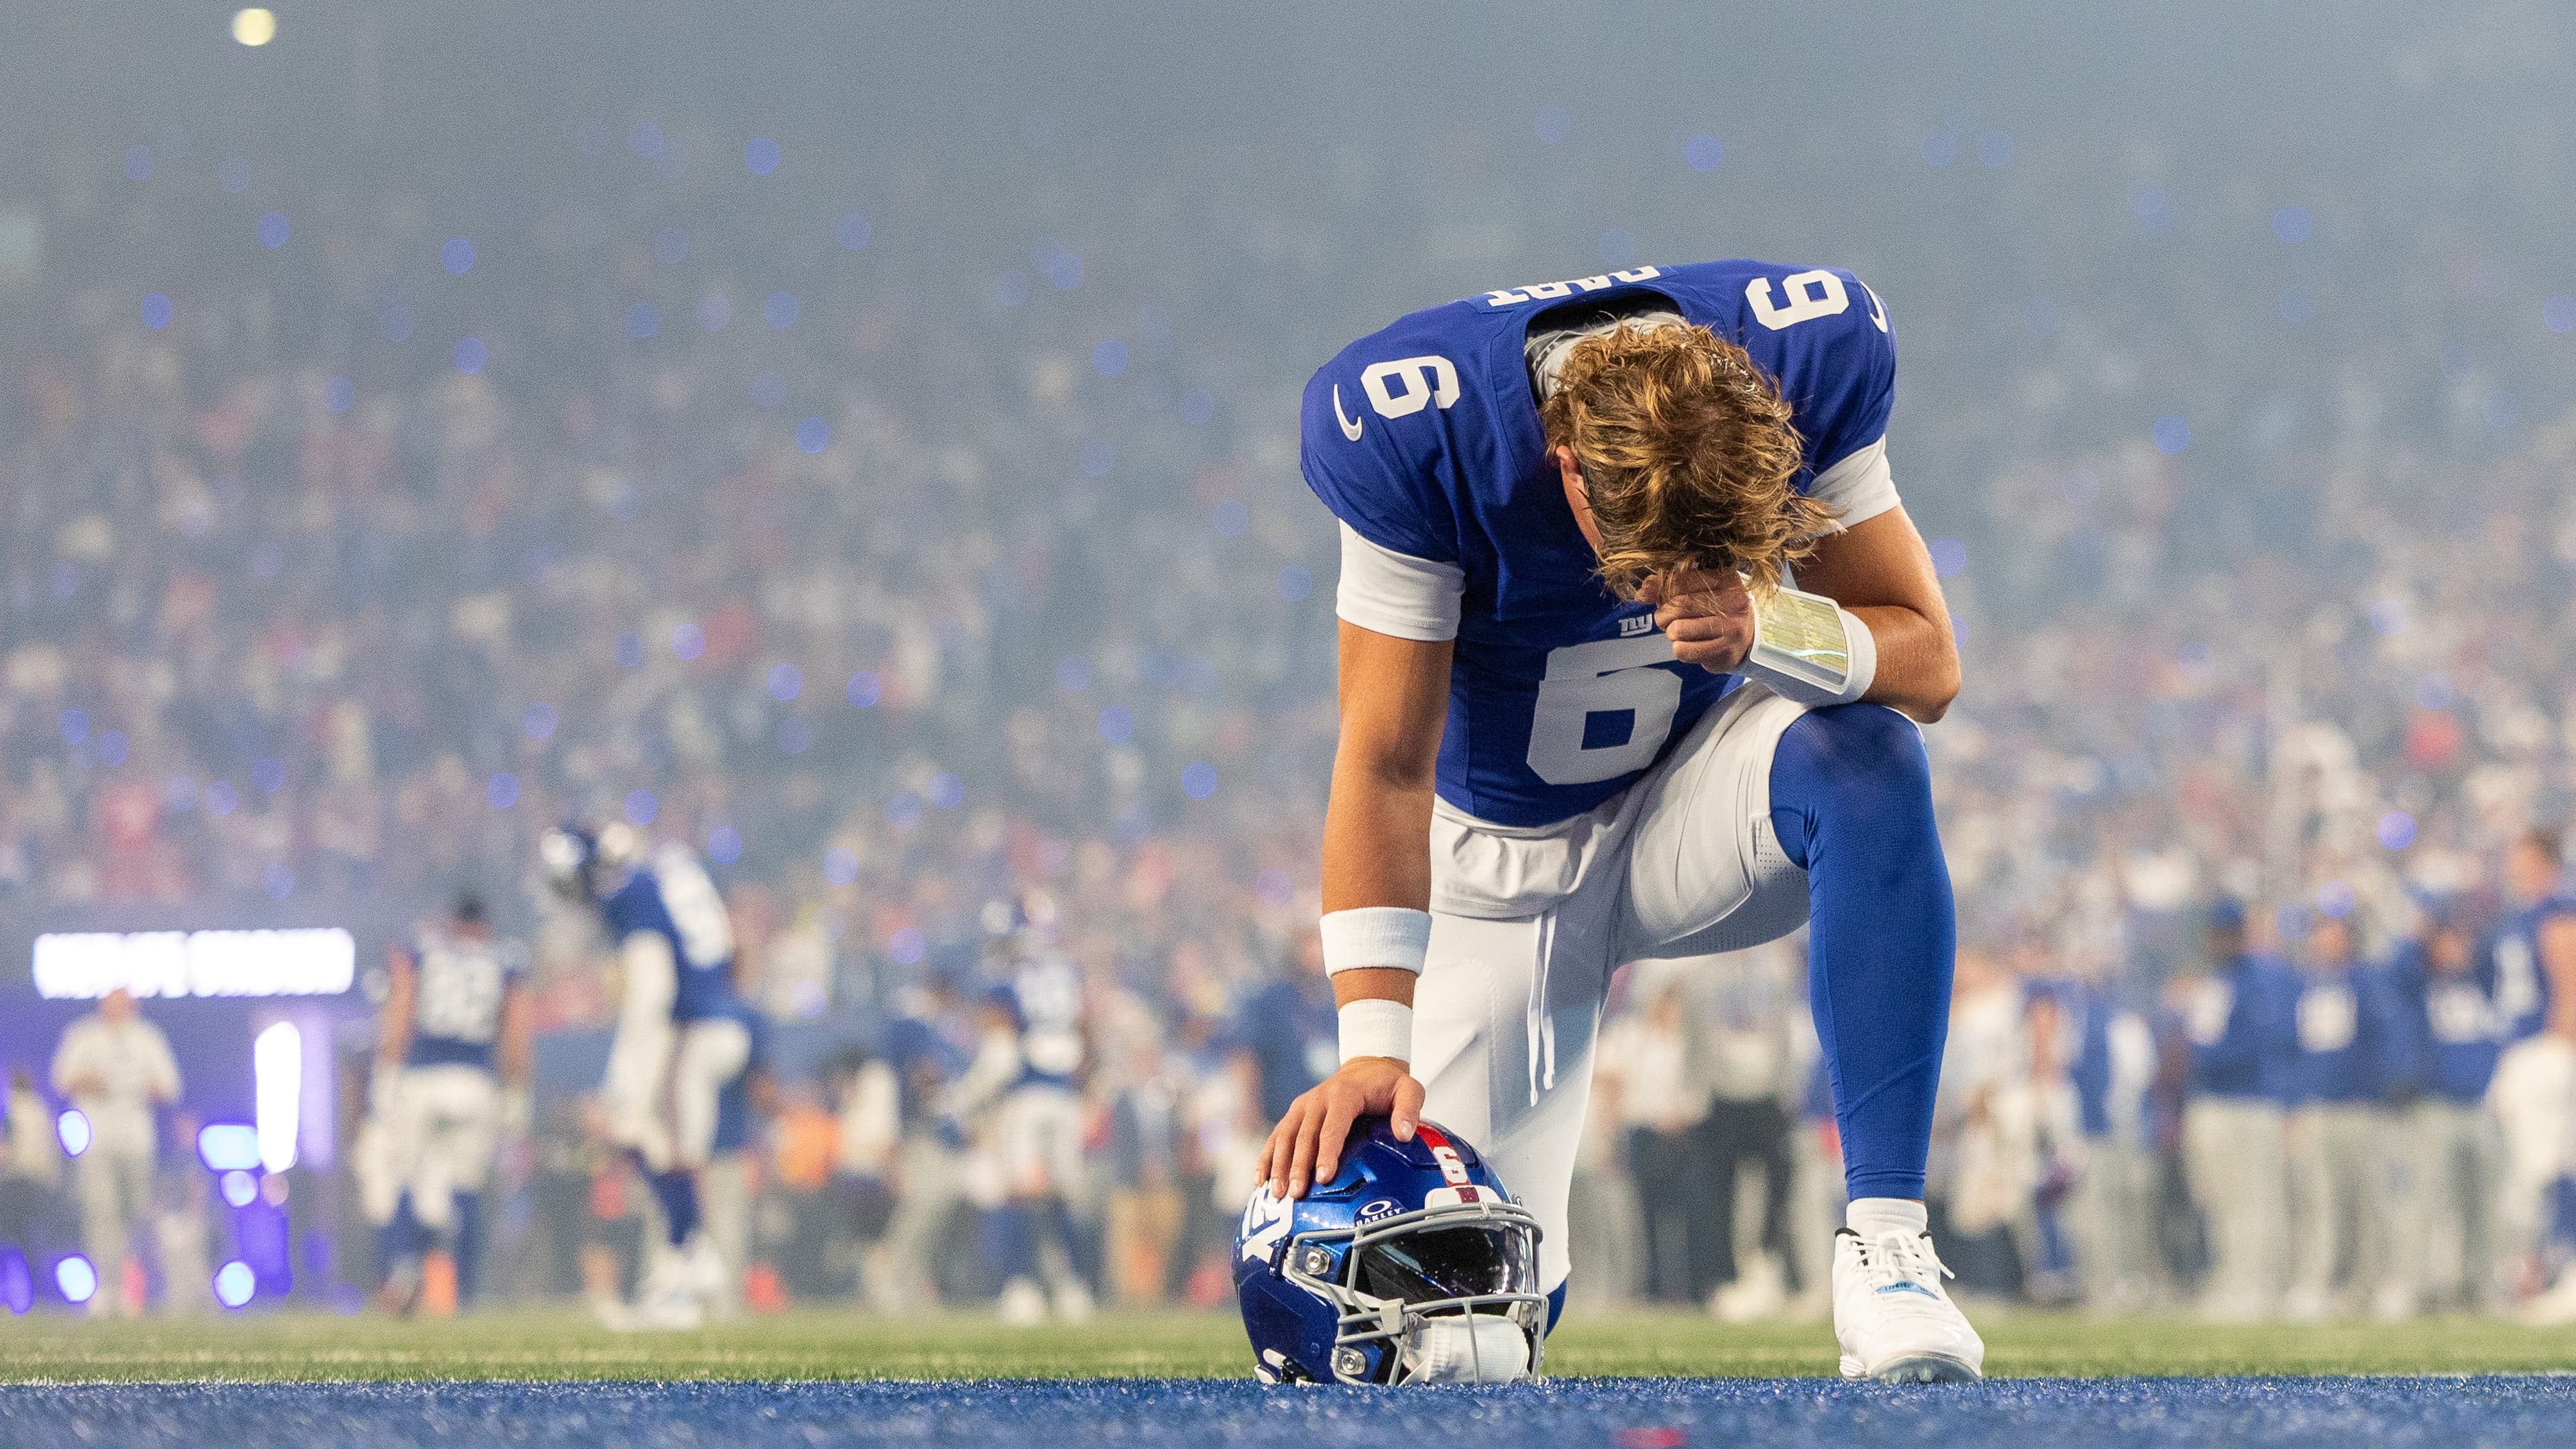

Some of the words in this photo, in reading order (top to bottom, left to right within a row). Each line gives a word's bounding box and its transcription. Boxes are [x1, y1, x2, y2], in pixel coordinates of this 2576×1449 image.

[1745, 270, 1849, 331] 6
[1360, 355, 1460, 419] 6
[1618, 613, 1653, 637] ny
[1526, 633, 1683, 786] 6
[1433, 1146, 1468, 1183] 6
[1356, 1208, 1402, 1227] OAKLEY
